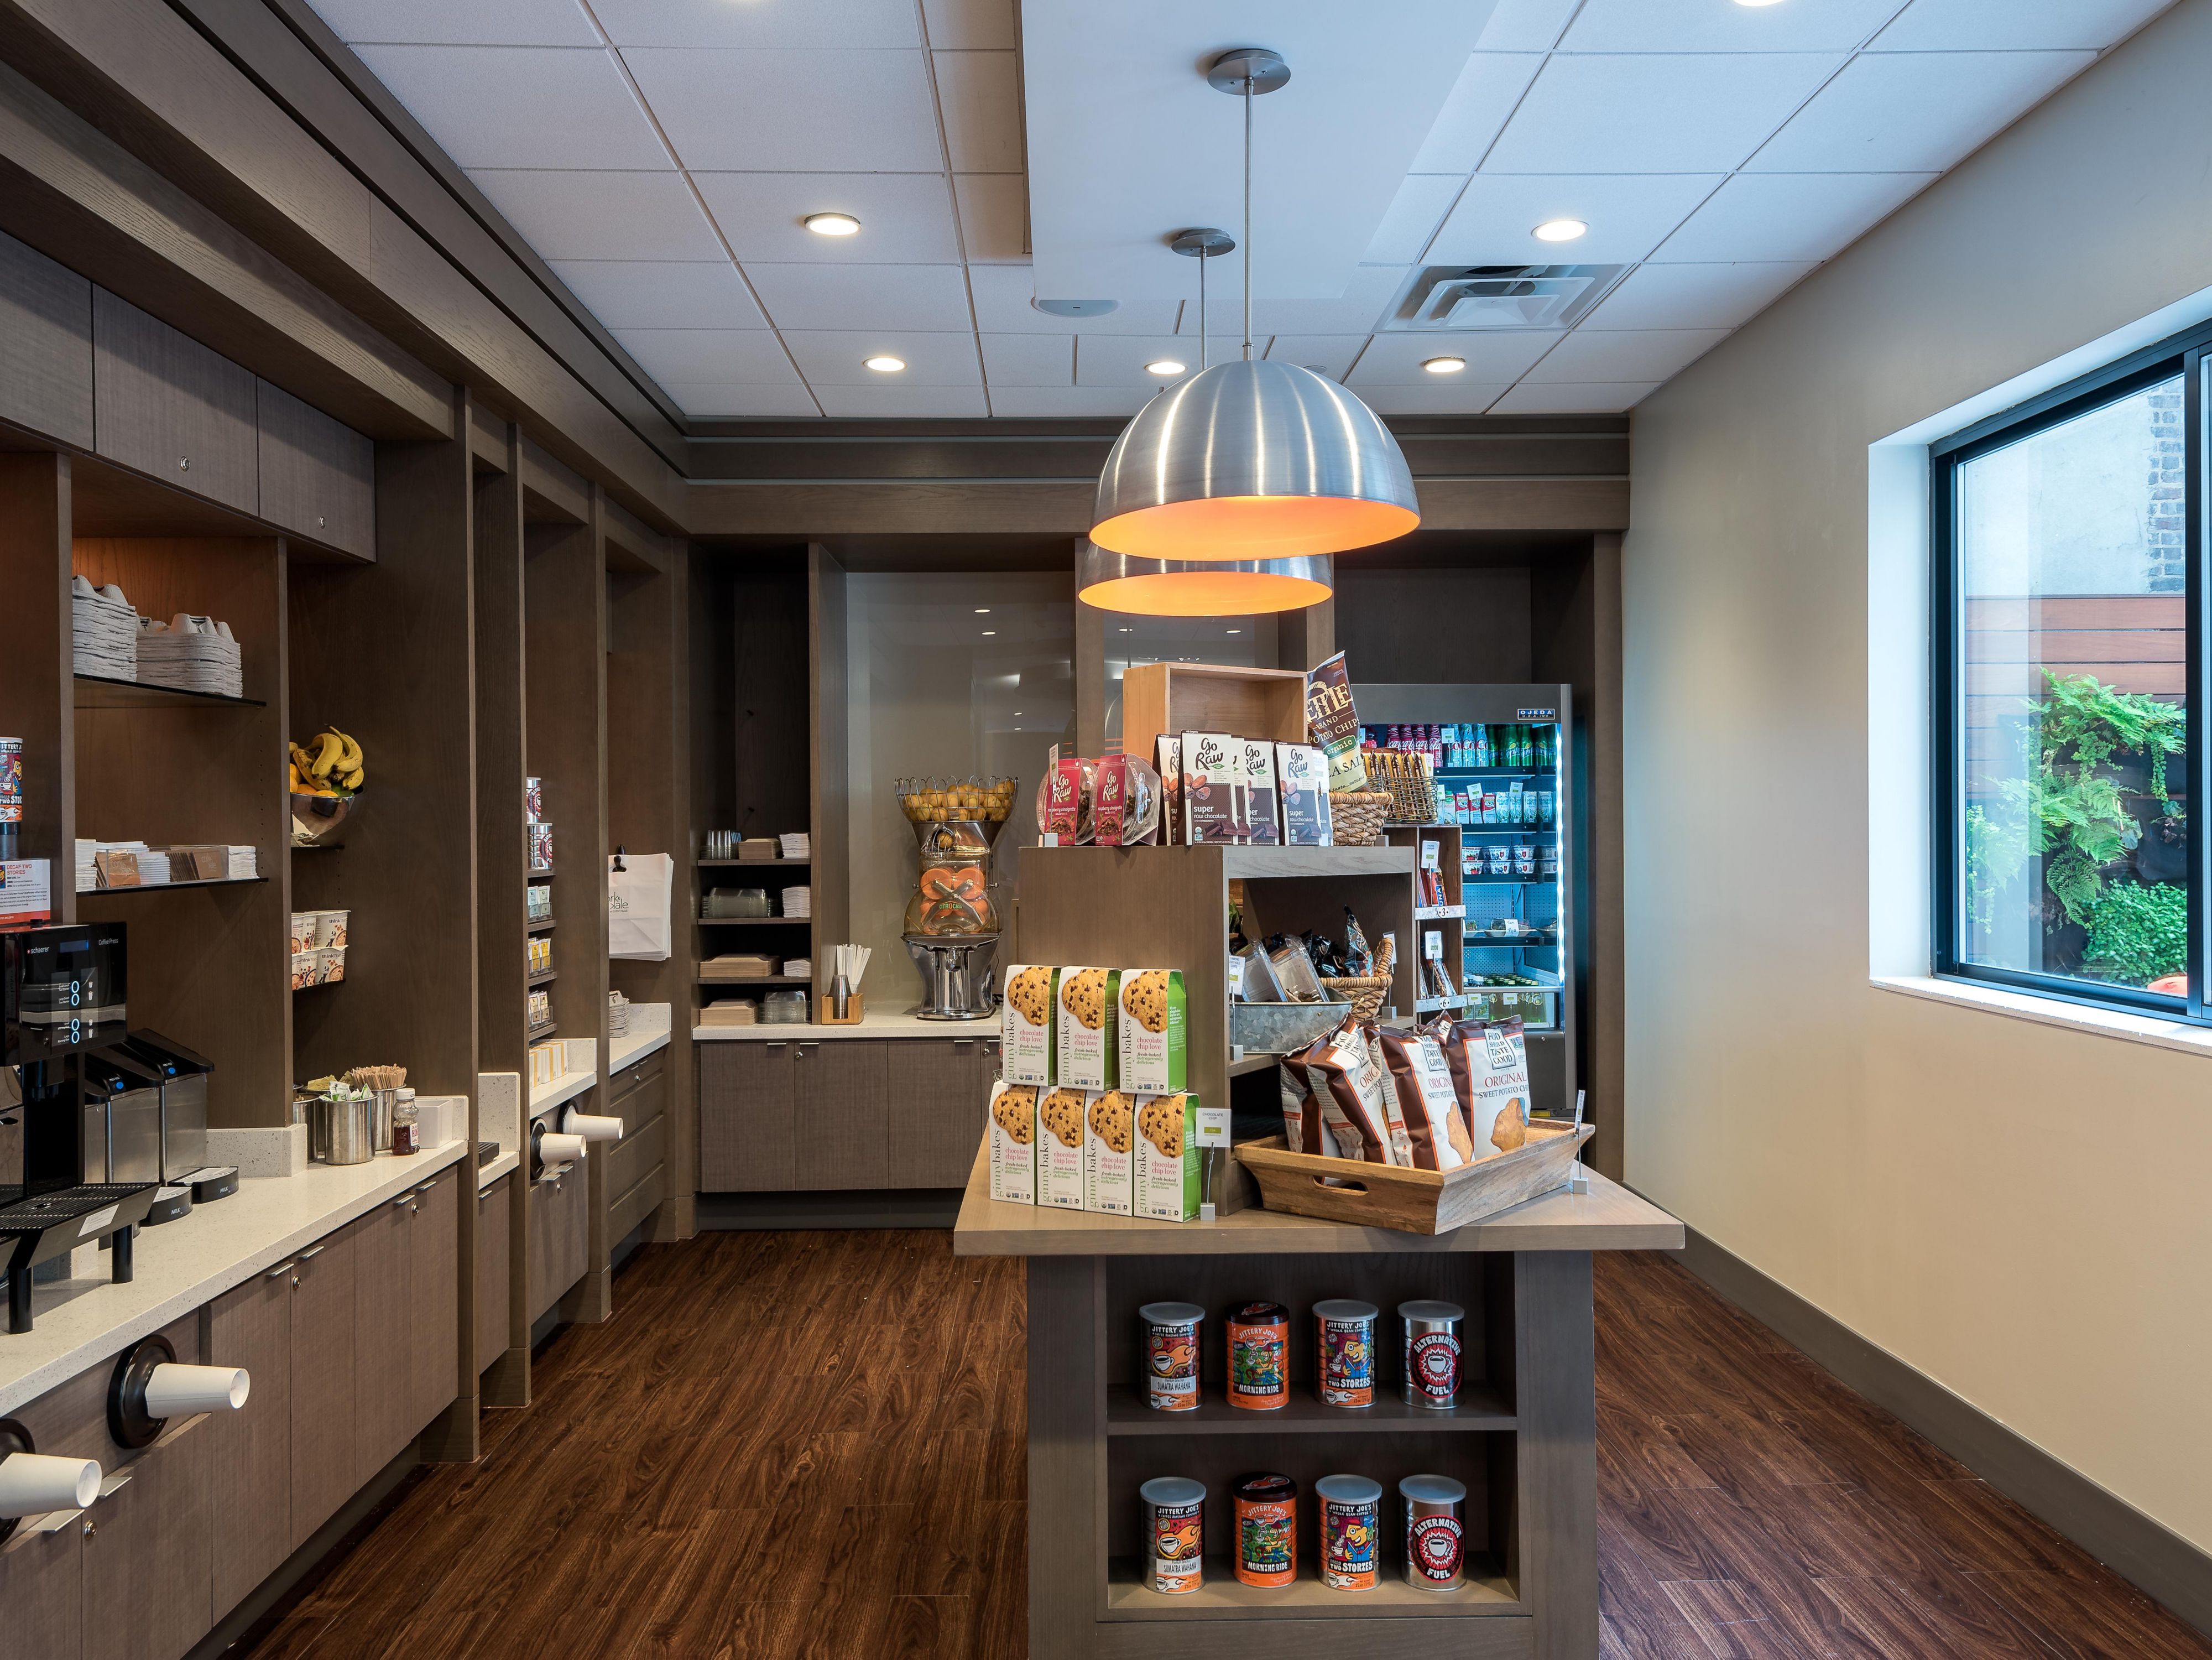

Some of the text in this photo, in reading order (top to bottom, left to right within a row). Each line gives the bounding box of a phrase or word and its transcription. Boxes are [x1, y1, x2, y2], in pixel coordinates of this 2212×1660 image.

[1307, 683, 1353, 723] ETTLE
[1316, 715, 1338, 730] BRAND
[1308, 730, 1333, 743] POTATO
[1201, 737, 1217, 755] Go
[1327, 740, 1353, 756] organic
[1245, 744, 1260, 761] Go
[1291, 748, 1303, 764] Go
[1195, 752, 1223, 771] Raw
[1287, 762, 1308, 778] Raw
[1058, 774, 1069, 790] Go
[1107, 771, 1117, 787] Go
[1053, 786, 1072, 803] Raw
[1103, 783, 1119, 802] Raw
[1193, 806, 1214, 815] super
[1442, 908, 1446, 917] 3
[1490, 1047, 1510, 1056] TASTE
[1429, 1058, 1443, 1067] GOOD
[1493, 1055, 1512, 1065] GOOD
[1485, 1071, 1527, 1088] ORIGINAL
[1363, 1084, 1376, 1101] SWEET
[1428, 1090, 1455, 1100] SWEET POTATO
[1479, 1086, 1518, 1099] SWEET POTATO
[1005, 1147, 1029, 1155] chocolate
[1101, 1156, 1126, 1164] chocolate
[1151, 1161, 1178, 1169] chocolate
[1151, 1167, 1164, 1175] chip
[1152, 1325, 1194, 1334] JITTERY JOE'S
[1239, 1328, 1278, 1340] JITTERY JOE'S
[1413, 1334, 1460, 1356] ALTERNATIVE
[1157, 1381, 1191, 1391] SUMATRA WAHANA
[1239, 1383, 1279, 1394] MORNING RIDE
[1340, 1377, 1370, 1388] STORIES
[1426, 1384, 1450, 1396] FUEL
[1186, 1504, 1199, 1514] JOE'S
[1248, 1505, 1287, 1517] JITTERY JOE'S
[1328, 1504, 1371, 1513] JITTERY JOE'S
[1414, 1518, 1462, 1538] ALTERNATIVE
[1164, 1562, 1197, 1573] SUMATRA WAHANA
[1248, 1561, 1288, 1572] MORNING RIDE
[1342, 1560, 1373, 1573] STORIES
[1427, 1568, 1451, 1579] FUEL
